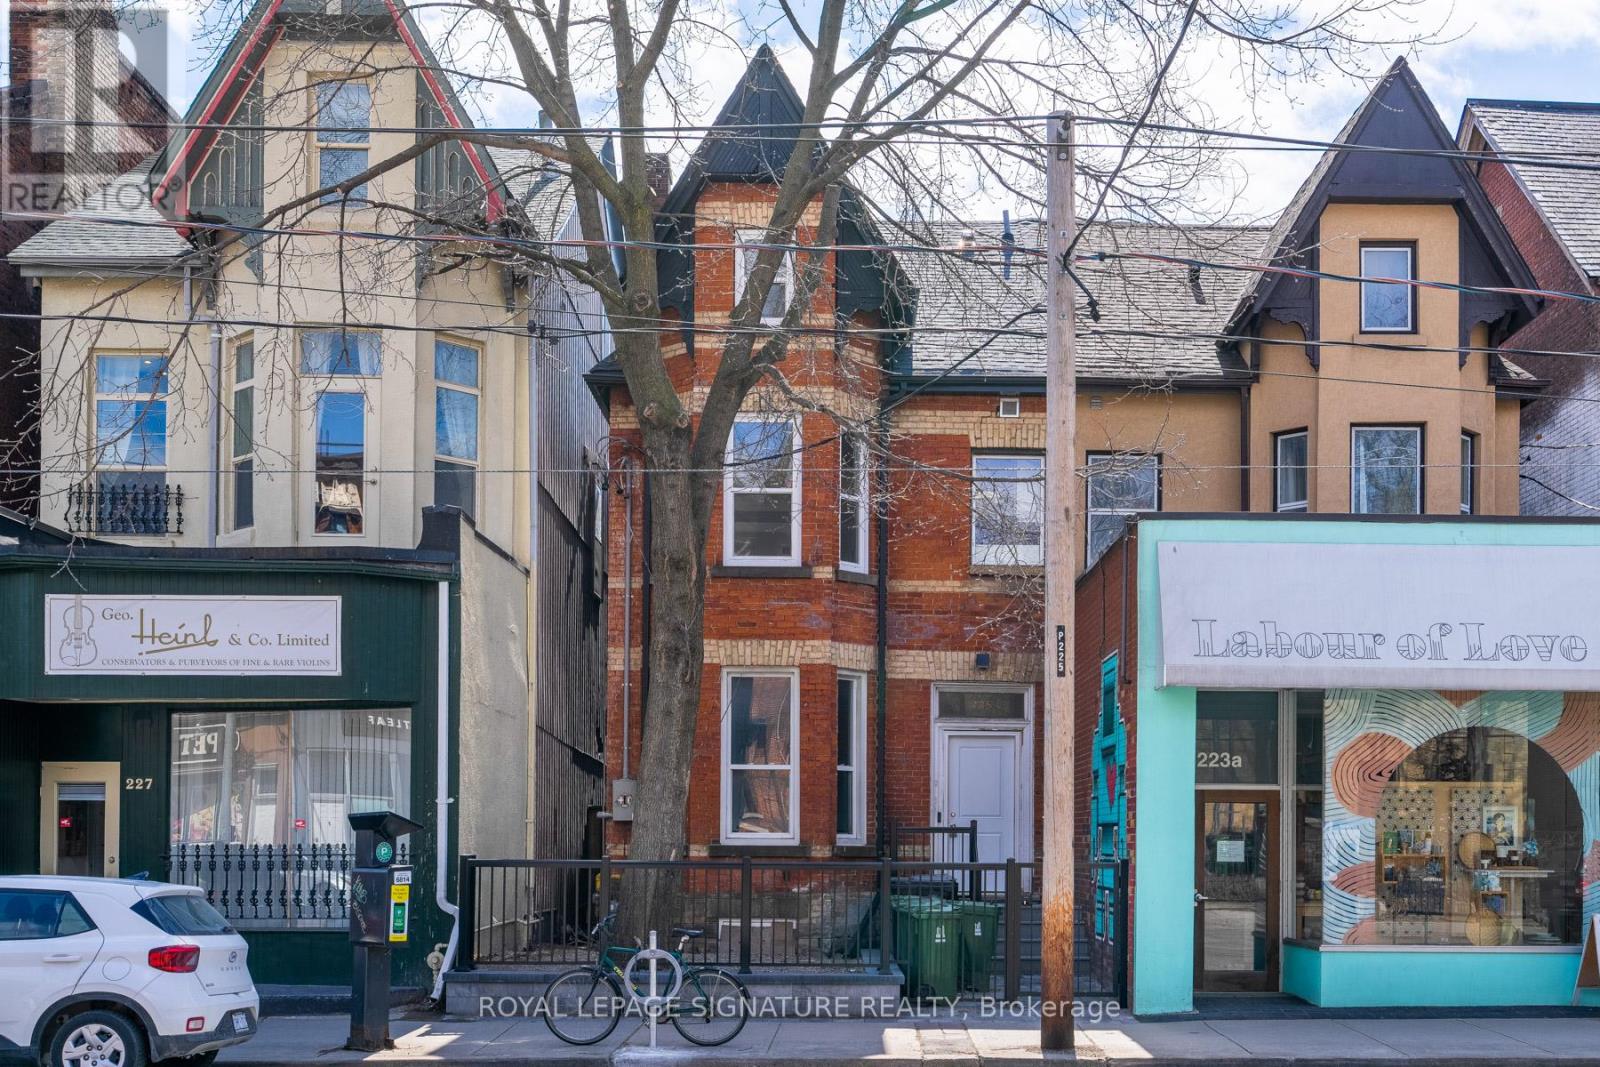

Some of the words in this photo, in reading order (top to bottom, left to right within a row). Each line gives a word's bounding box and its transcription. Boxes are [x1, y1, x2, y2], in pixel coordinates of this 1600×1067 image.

[101, 607, 134, 621] Geo.
[228, 633, 242, 646] &
[248, 633, 272, 646] Co.
[277, 633, 329, 646] Limited
[1191, 619, 1386, 660] Labour
[1396, 622, 1453, 661] of
[1459, 622, 1588, 662] Love
[101, 658, 166, 666] CONSERVATORS
[178, 658, 227, 666] PURVEYORS
[229, 658, 240, 666] OF
[242, 658, 261, 666] FINE
[273, 658, 295, 666] RARE
[296, 658, 331, 666] VIOLINS
[1197, 752, 1242, 768] 223a
[125, 778, 153, 790] 227
